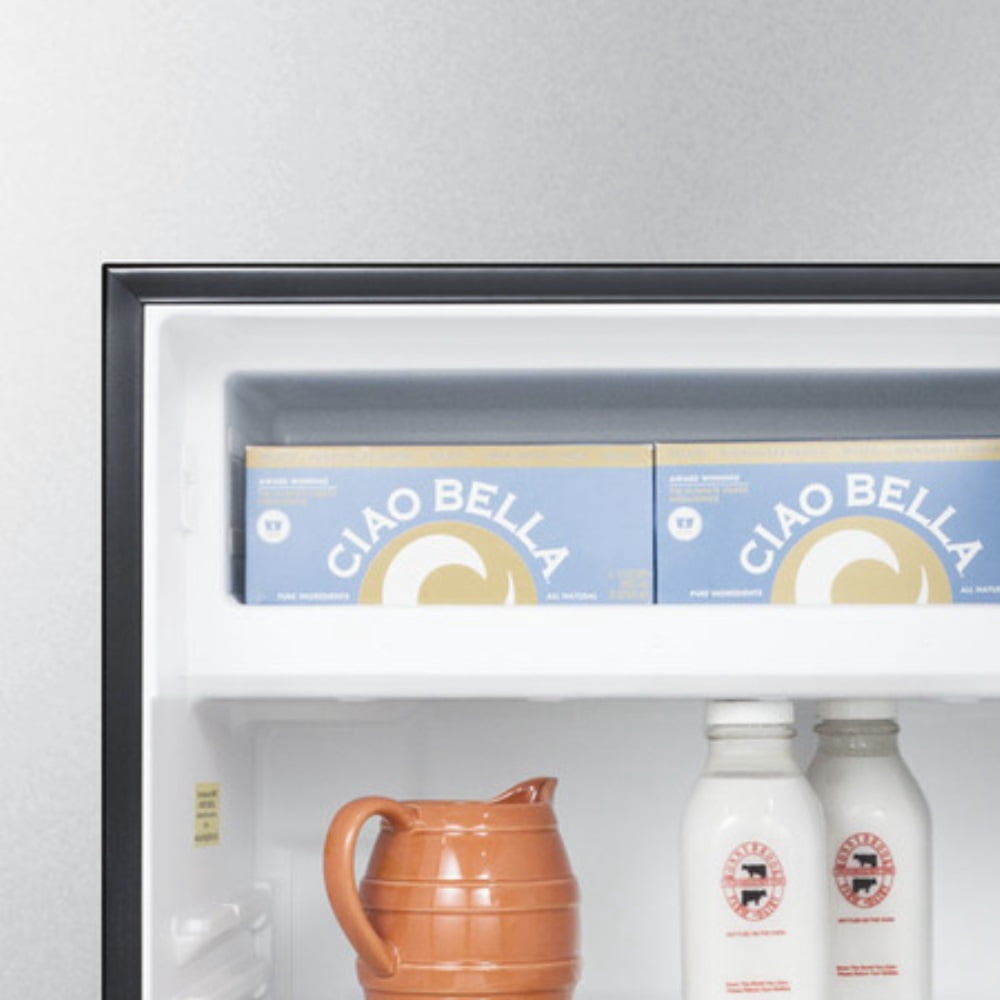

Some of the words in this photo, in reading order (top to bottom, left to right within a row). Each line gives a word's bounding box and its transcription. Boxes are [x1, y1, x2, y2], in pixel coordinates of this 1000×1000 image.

[327, 488, 422, 580] CIAO
[434, 479, 571, 583] BELLA
[740, 483, 834, 576] CIAO
[845, 473, 985, 577] BELLA
